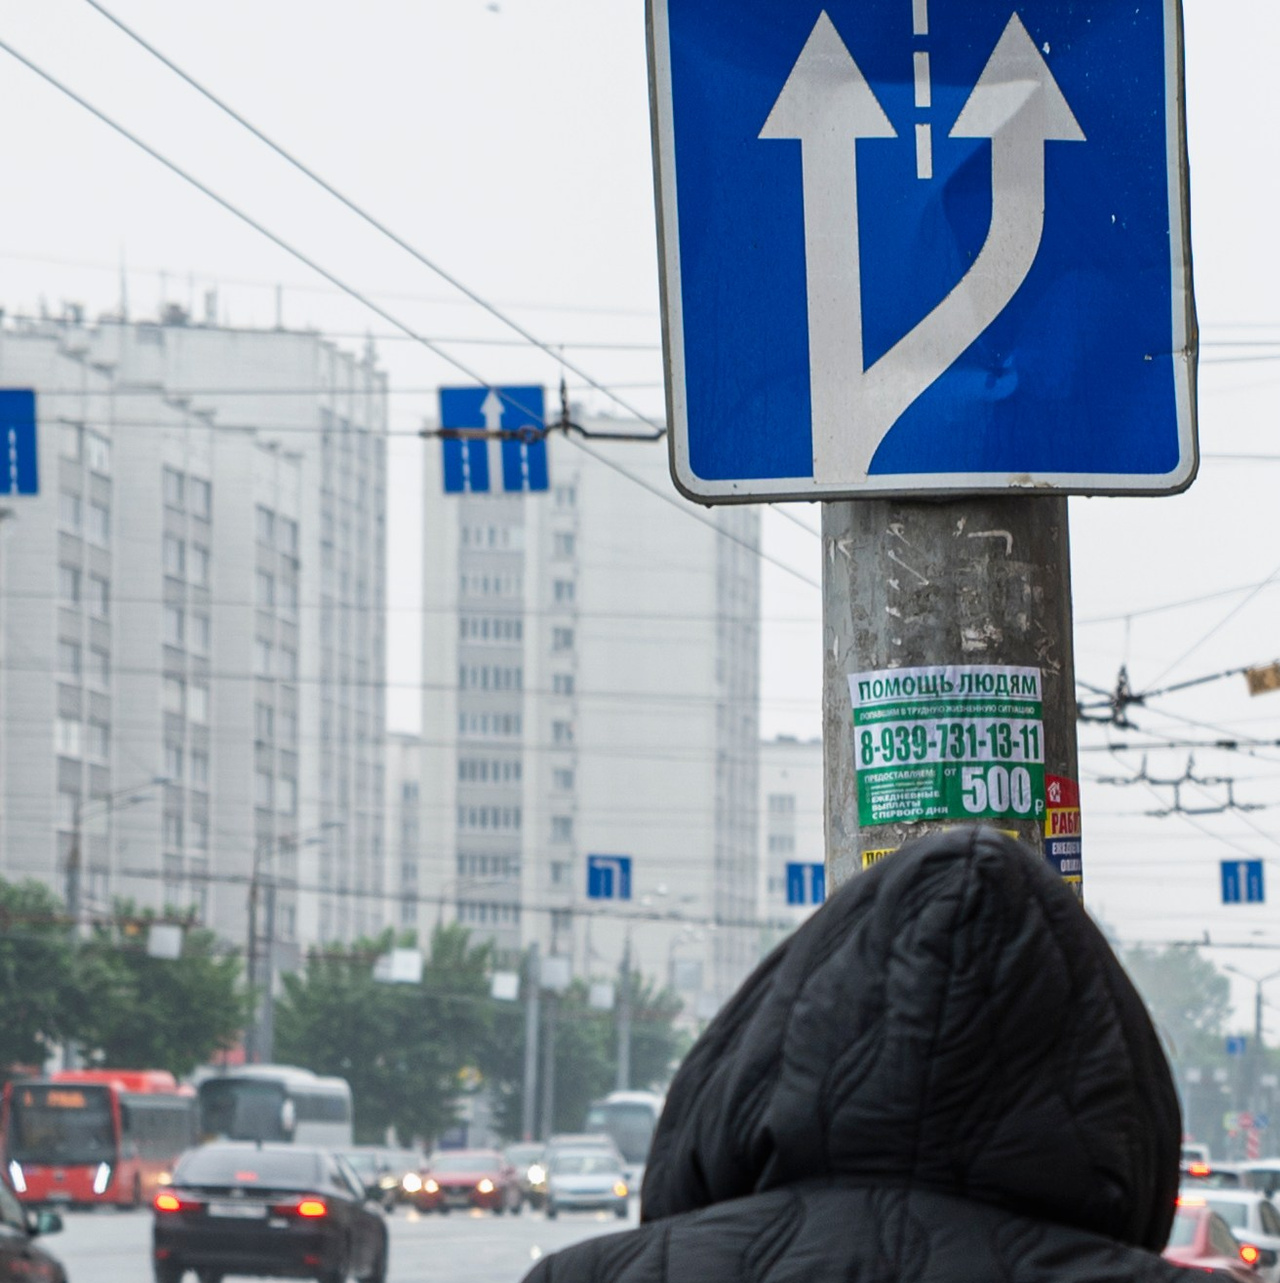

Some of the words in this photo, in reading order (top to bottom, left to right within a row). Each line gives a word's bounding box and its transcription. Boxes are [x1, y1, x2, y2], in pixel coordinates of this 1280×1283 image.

[858, 674, 954, 701] ПОМОЩЬ
[959, 672, 1038, 697] ЛЮДЯМ
[900, 707, 907, 716] В
[906, 706, 946, 717] ТРУДНУЮ
[945, 705, 997, 714] ЖИЗНЕННУЮ
[997, 704, 1036, 716] СИТУАЦИЮ
[860, 722, 1040, 767] 8-939-731-13-11
[871, 789, 941, 804] ЕЖЕДНЕВНЫЕ
[961, 765, 1032, 814] 500
[871, 800, 922, 812] ВЫПЛАТЫ
[878, 807, 925, 819] ПЕРВОГО
[925, 806, 949, 816] ДНЯ
